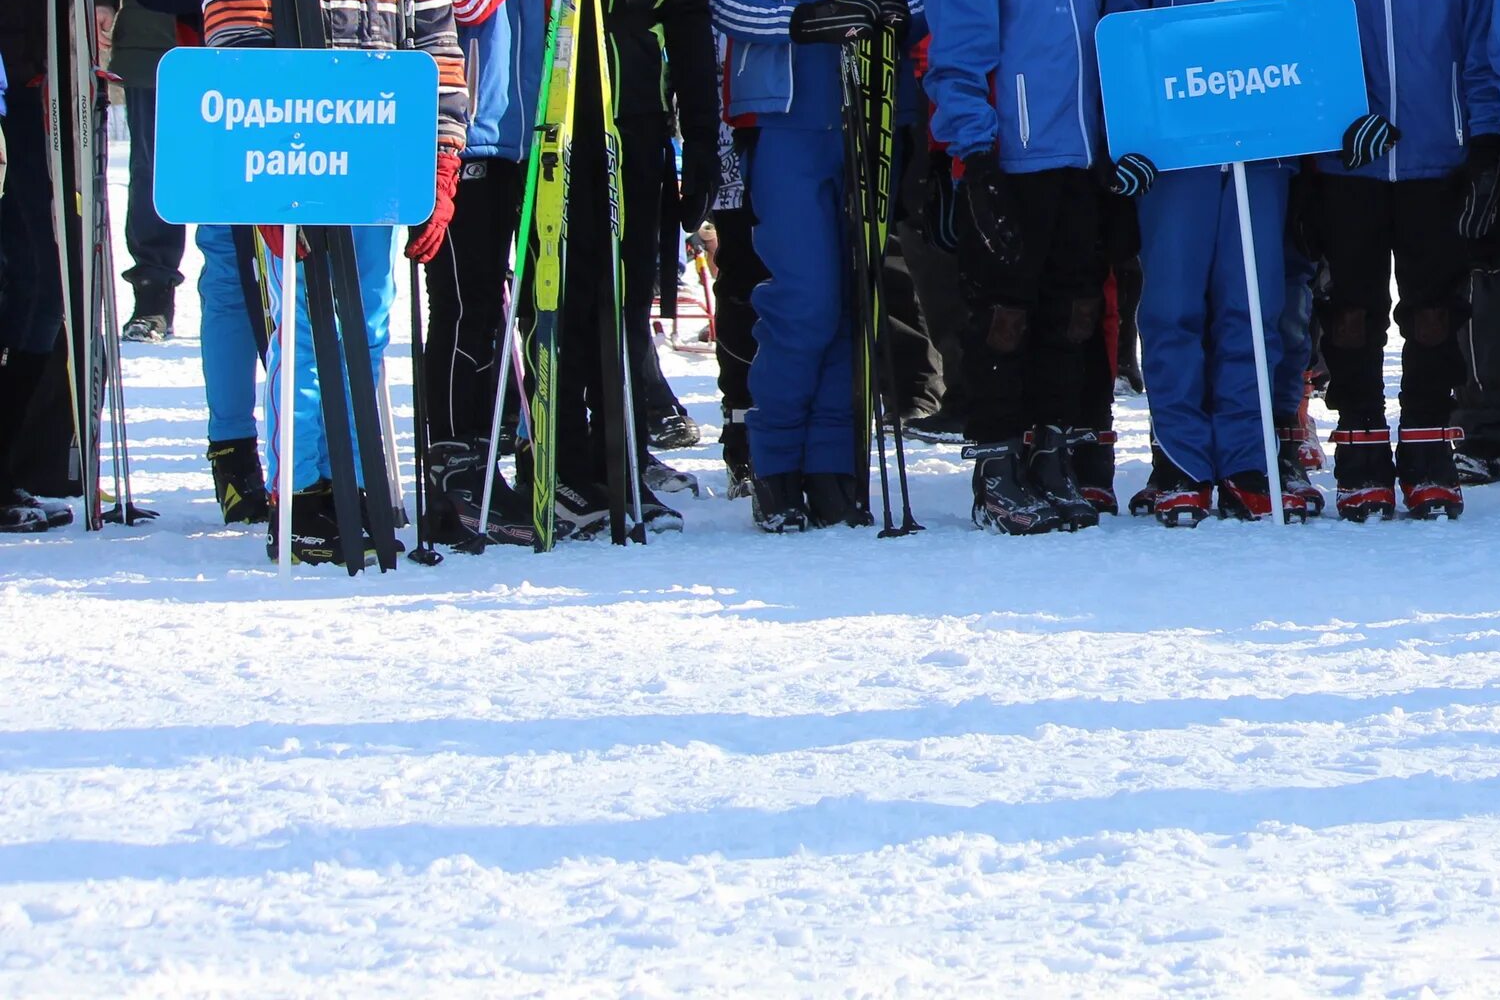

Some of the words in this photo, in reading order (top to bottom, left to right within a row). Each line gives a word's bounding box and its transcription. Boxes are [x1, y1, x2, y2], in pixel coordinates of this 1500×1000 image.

[1164, 62, 1302, 99] г.Бердск
[200, 91, 396, 130] Ордынский
[877, 25, 894, 214] FISCHER
[245, 143, 349, 182] район
[605, 133, 620, 238] FISCHER
